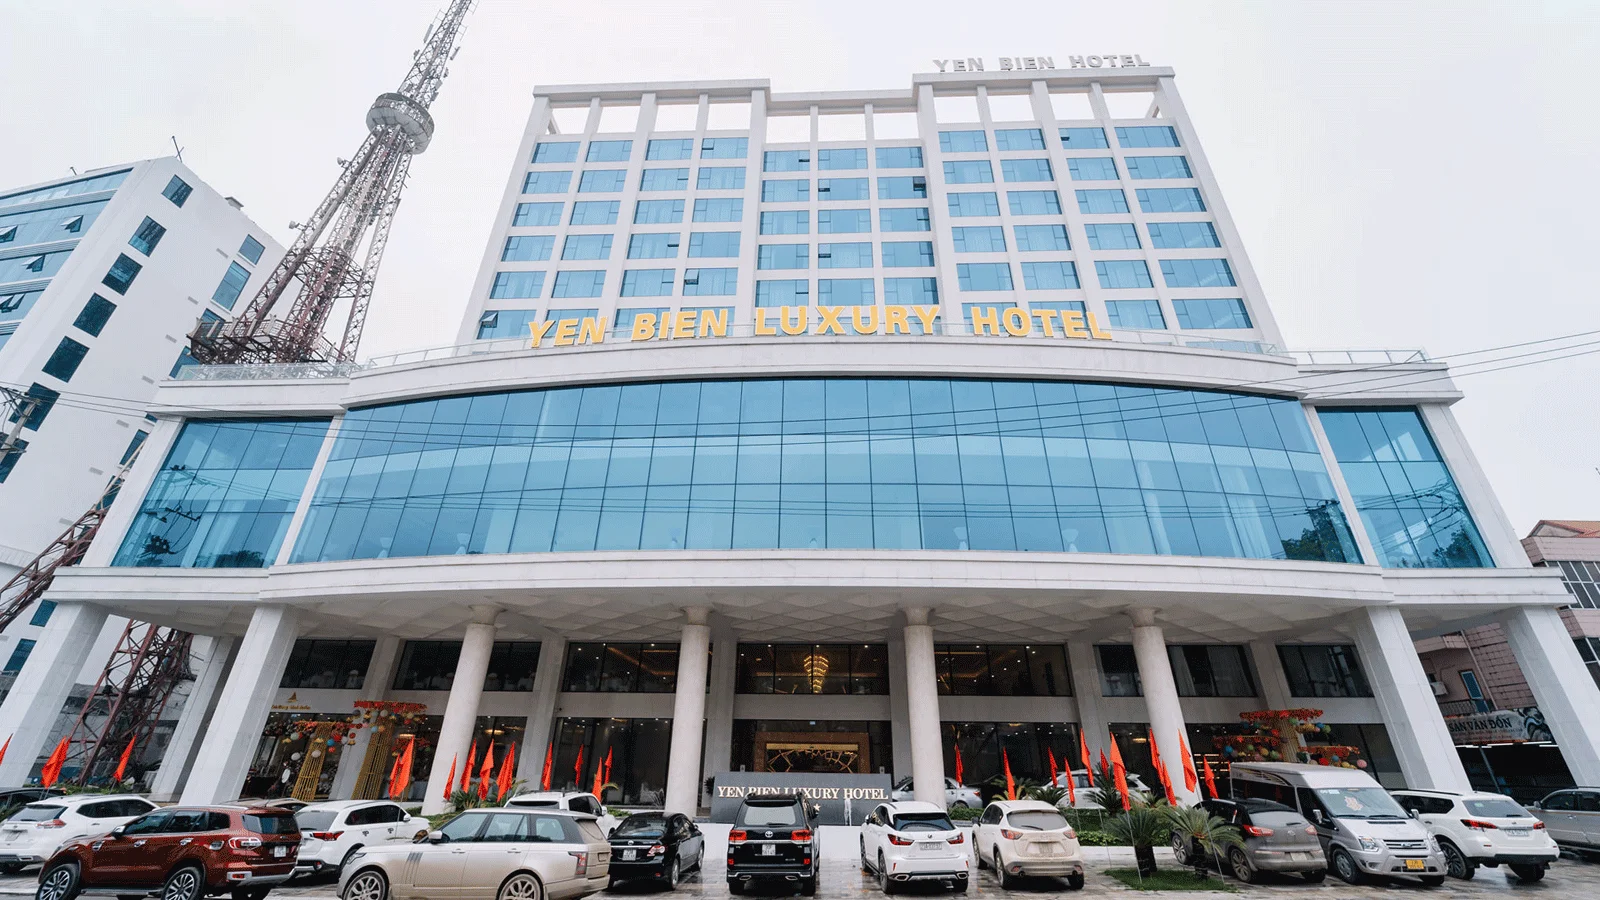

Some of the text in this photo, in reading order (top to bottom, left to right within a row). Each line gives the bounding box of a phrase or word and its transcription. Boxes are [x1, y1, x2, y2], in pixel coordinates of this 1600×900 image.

[933, 54, 1150, 72] YEN BIEN HOTEL
[528, 305, 1113, 348] YEN BIEN LUXURY HOTEL
[717, 786, 745, 798] YEN
[843, 788, 888, 799] HOTEL
